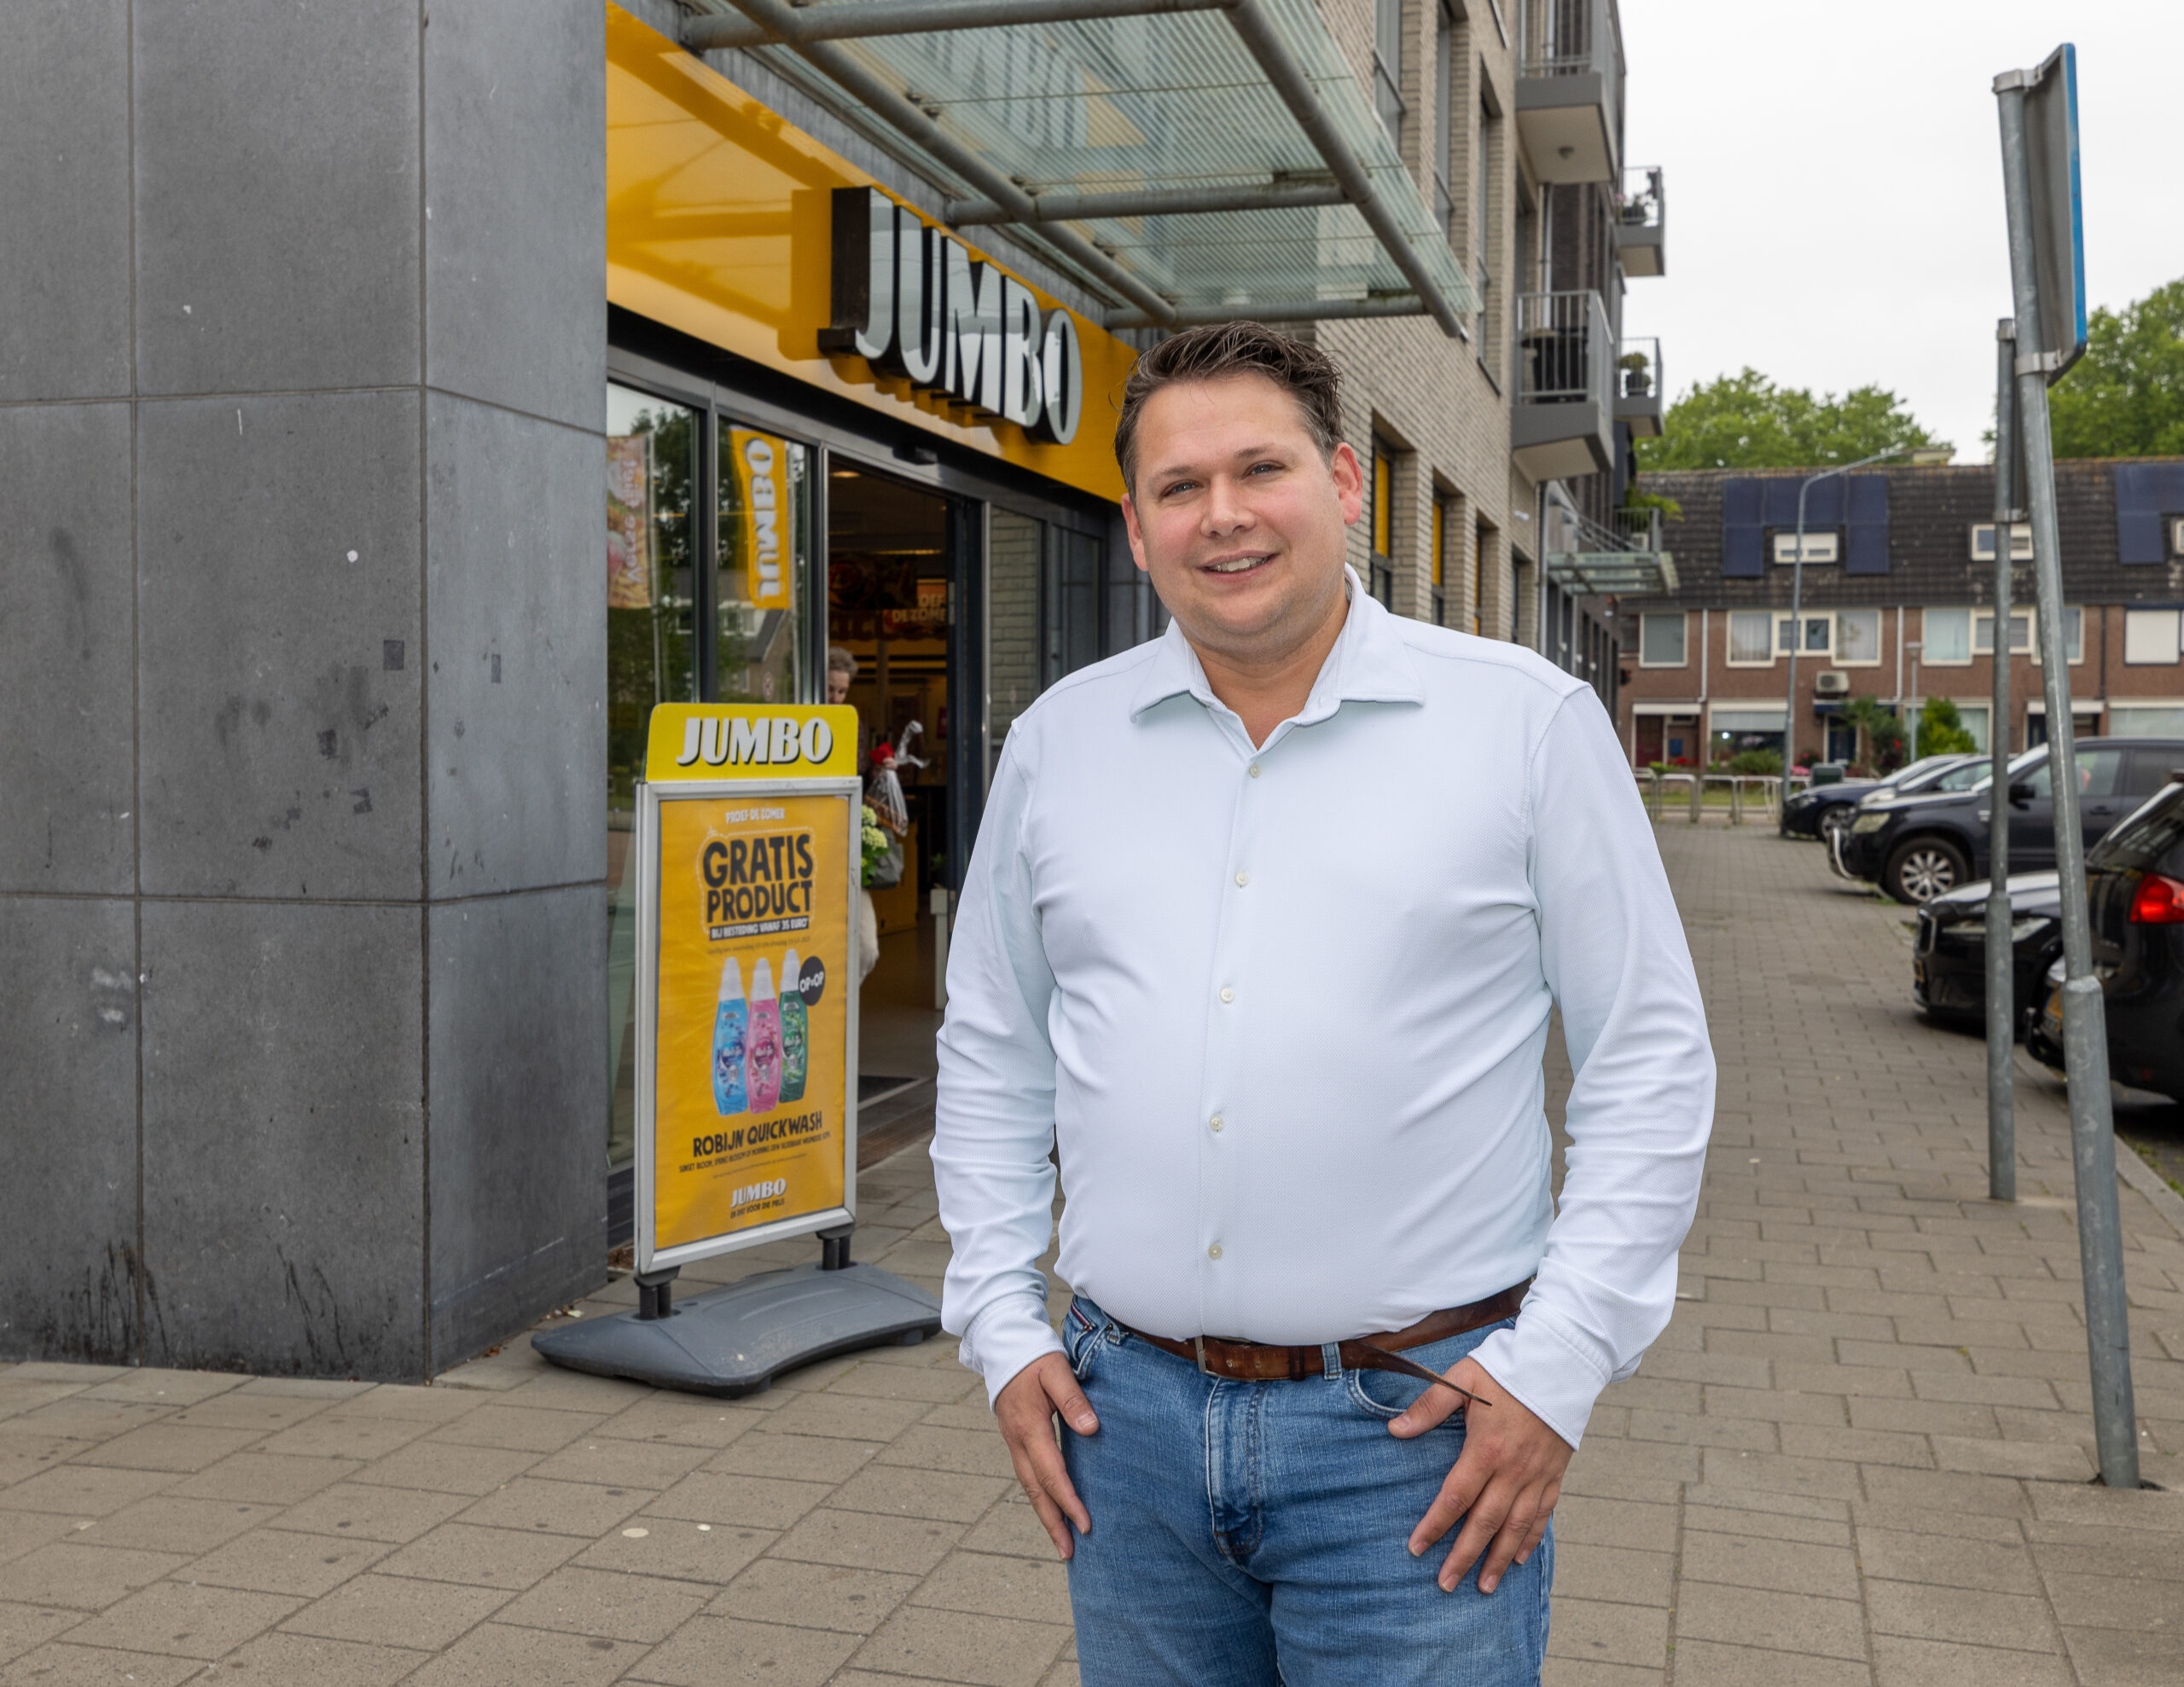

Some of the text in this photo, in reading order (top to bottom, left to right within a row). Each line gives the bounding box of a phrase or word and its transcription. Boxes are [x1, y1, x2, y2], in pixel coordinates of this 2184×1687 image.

[829, 186, 1083, 446] JUMBO
[676, 716, 834, 767] JUMBO
[760, 807, 785, 820] ZOMER
[702, 833, 813, 888] GRATIS
[706, 879, 813, 924] PRODUCT
[693, 1110, 823, 1157] ROBIJN QUICKWASH
[729, 1178, 787, 1209] JUMBO
